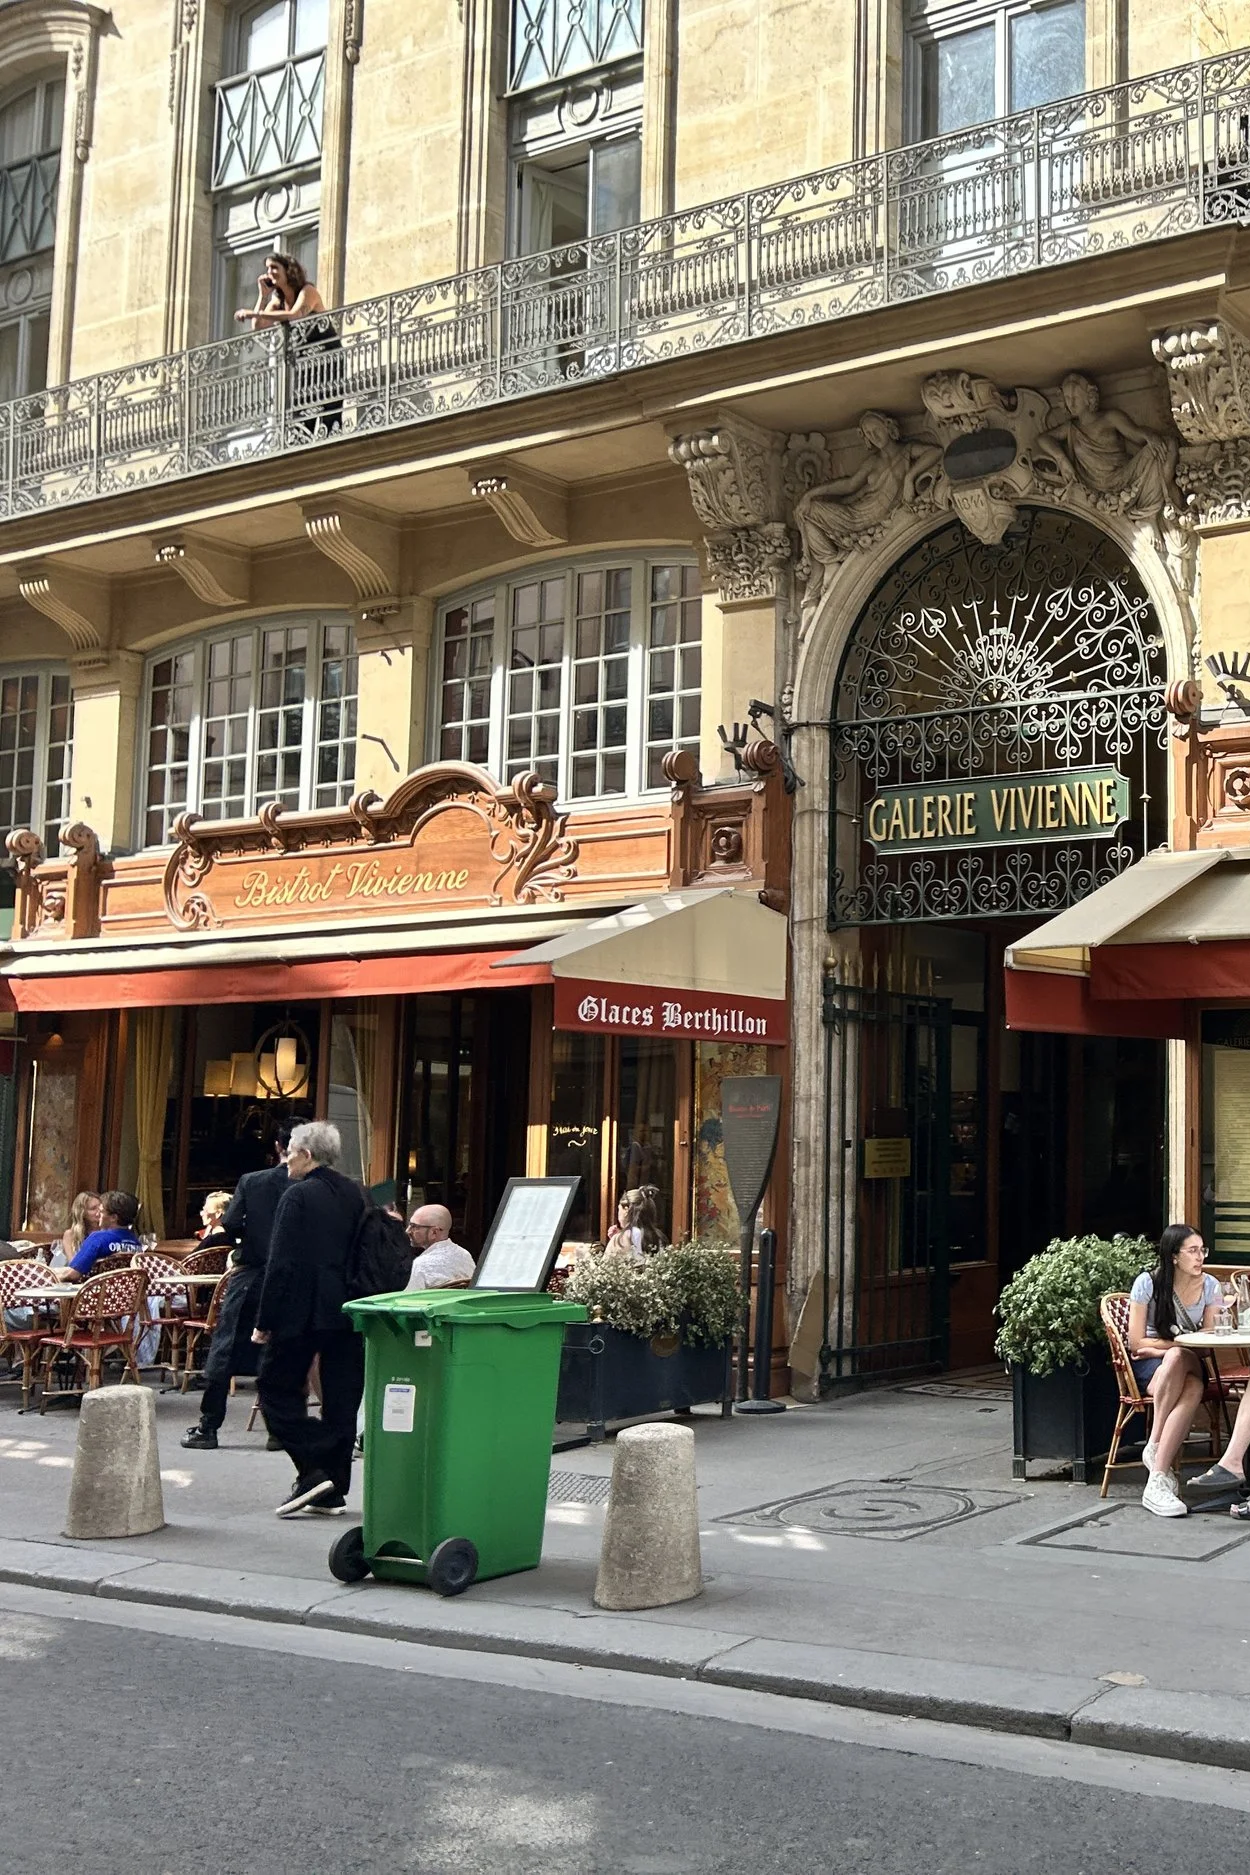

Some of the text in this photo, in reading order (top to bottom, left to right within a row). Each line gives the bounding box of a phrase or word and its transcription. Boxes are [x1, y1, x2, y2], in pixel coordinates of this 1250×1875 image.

[868, 778, 1117, 842] GALERIE VIVIENNE
[234, 859, 469, 908] Bistrot Vivienne
[577, 995, 768, 1036] Glaces Berthillon
